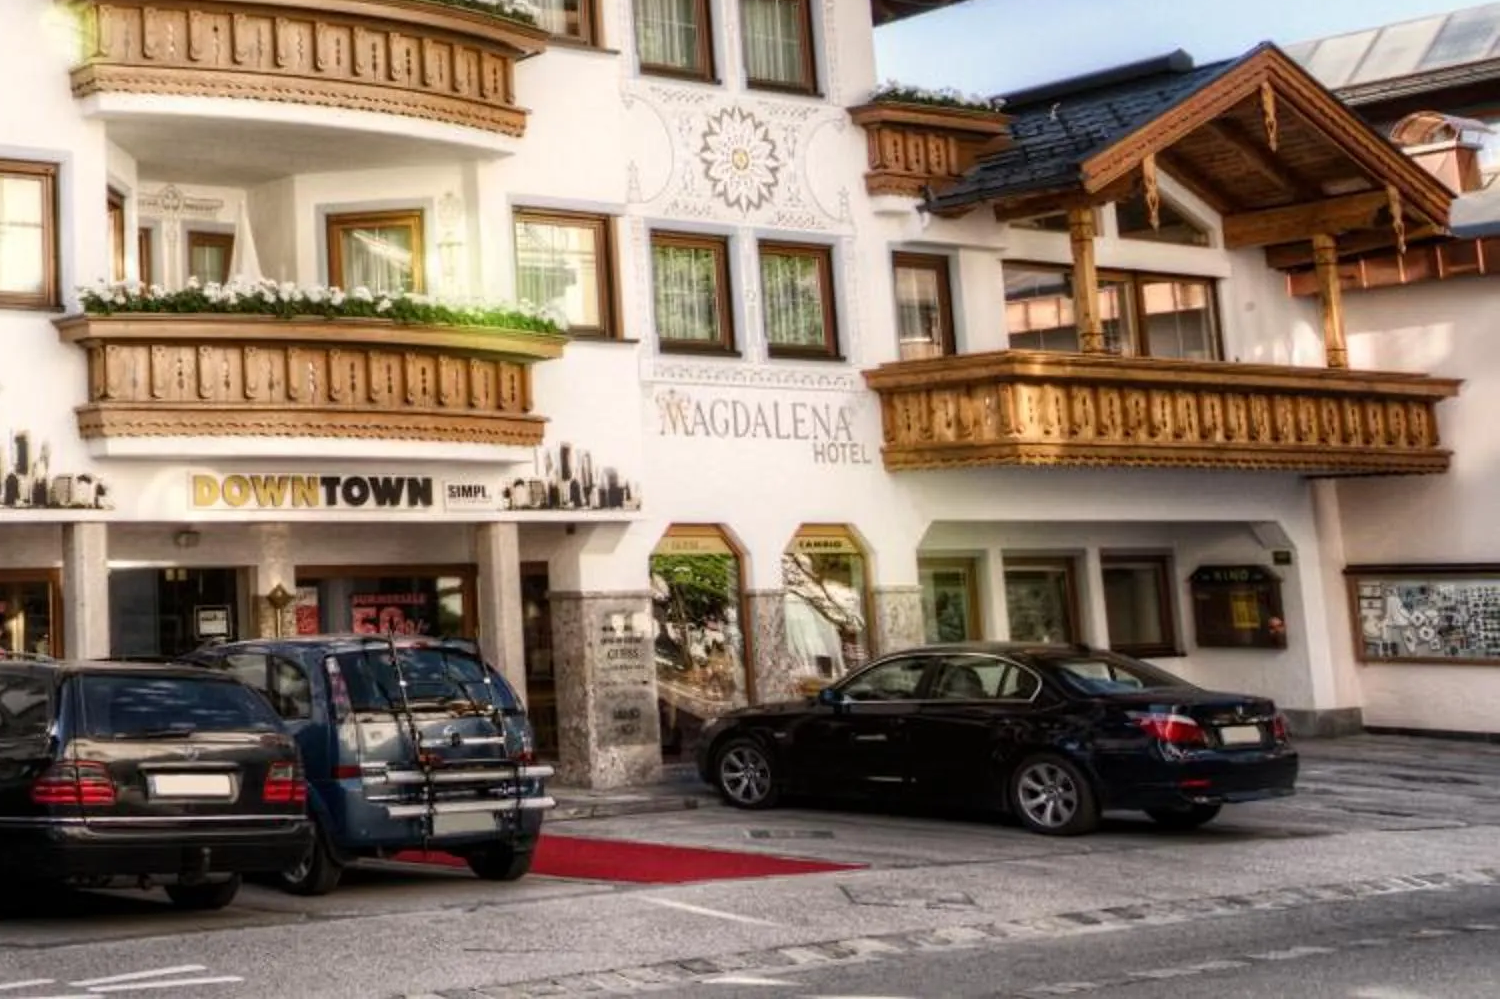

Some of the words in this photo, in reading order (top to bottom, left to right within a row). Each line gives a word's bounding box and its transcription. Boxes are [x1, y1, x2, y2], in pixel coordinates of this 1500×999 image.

[660, 399, 853, 441] MAGDALENA
[812, 443, 872, 465] HOTEL
[192, 474, 434, 507] DOWNTOWN
